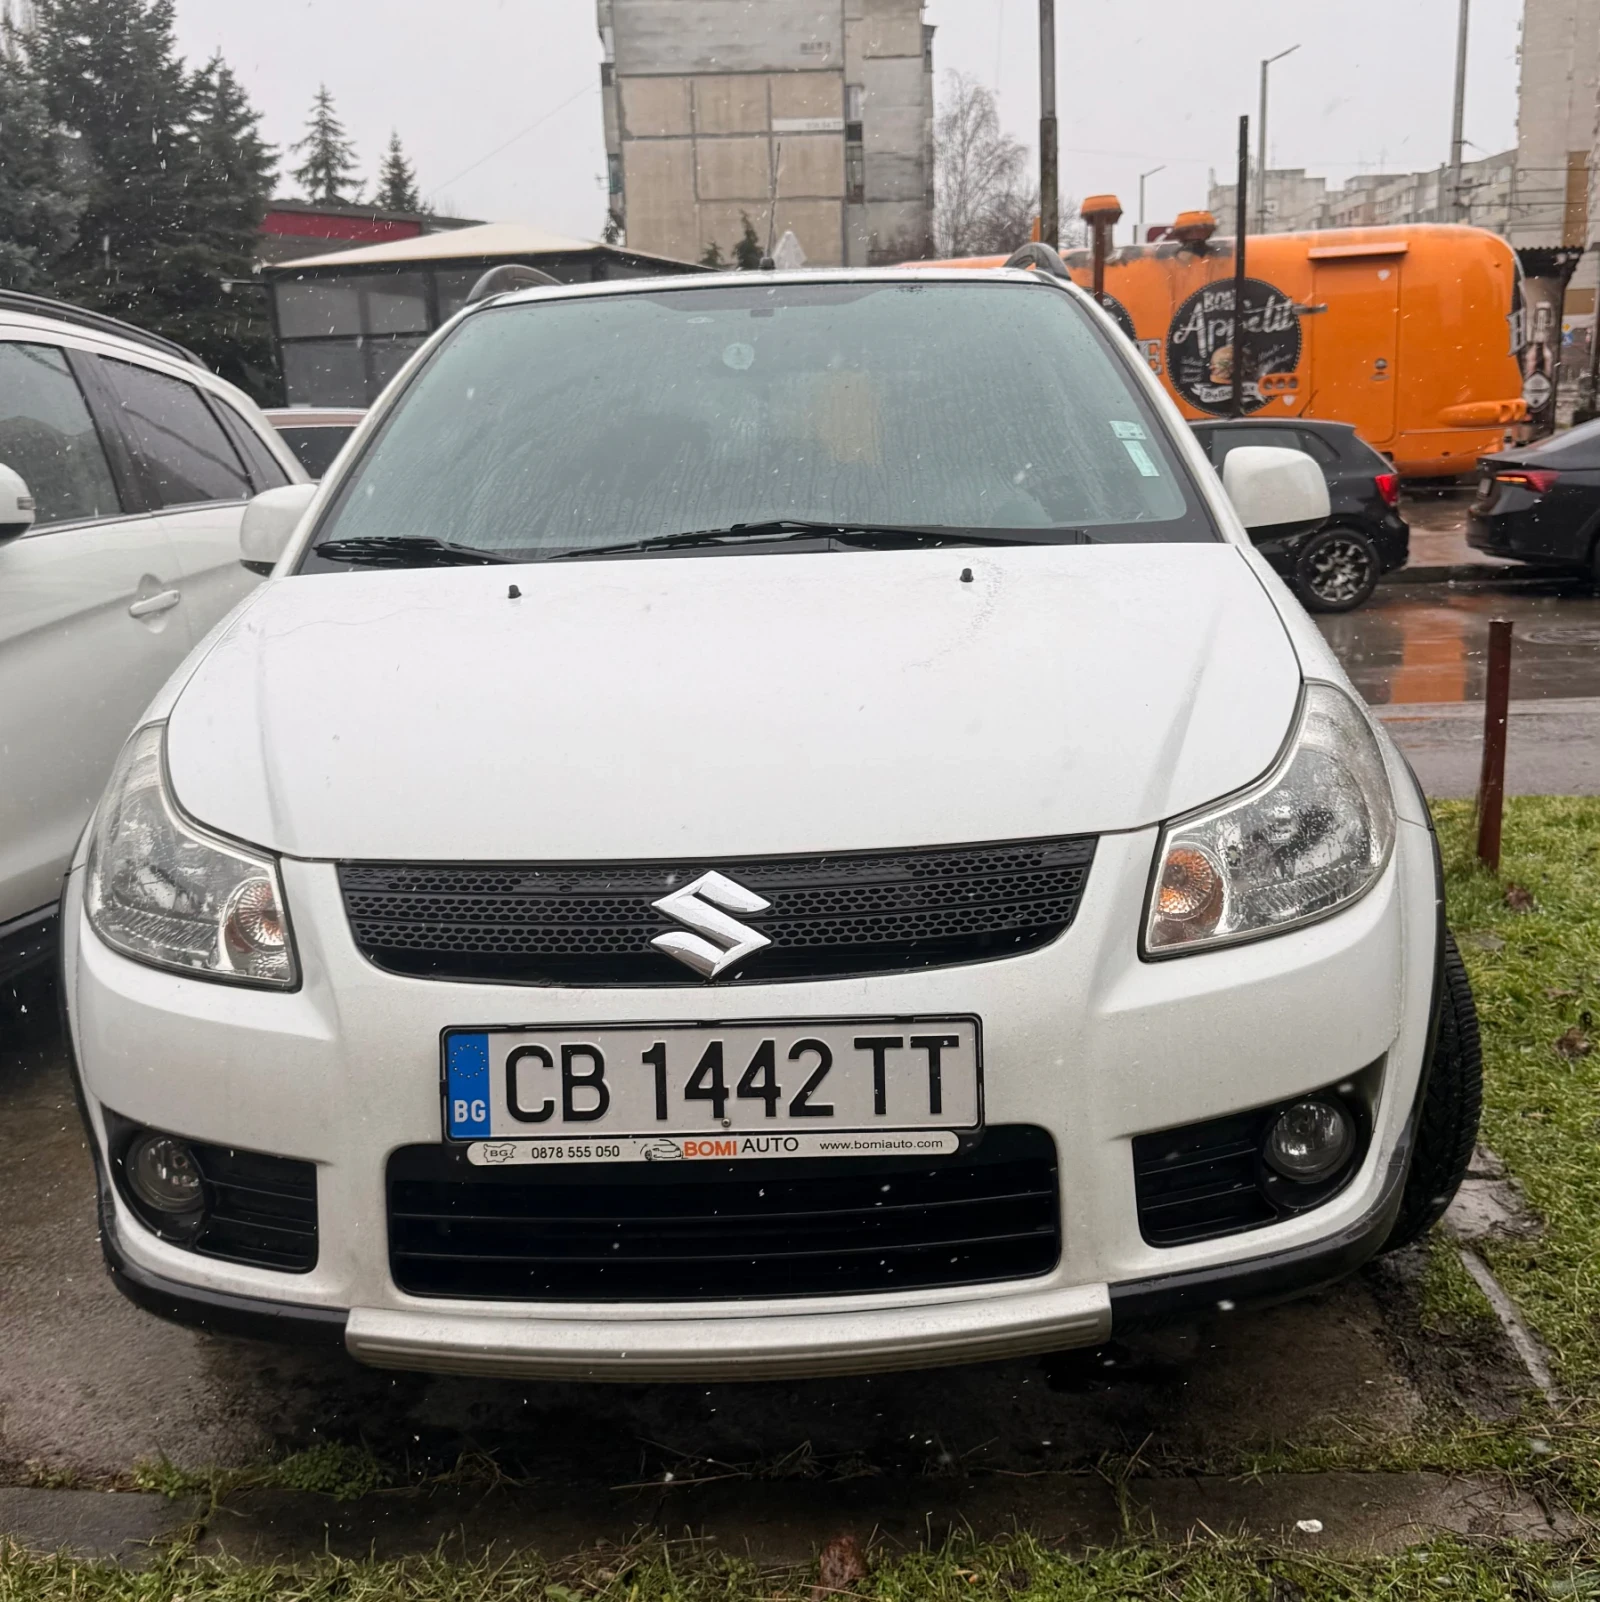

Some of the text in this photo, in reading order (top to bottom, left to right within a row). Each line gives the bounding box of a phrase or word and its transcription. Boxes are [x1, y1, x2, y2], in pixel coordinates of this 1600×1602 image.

[505, 1034, 960, 1122] CB 1442 TT
[454, 1099, 487, 1123] BG
[490, 1149, 508, 1157] BG
[531, 1144, 620, 1159] 0878 555 050
[684, 1136, 800, 1157] BOMI AUTO
[819, 1138, 944, 1151] www.bomiauto.com
